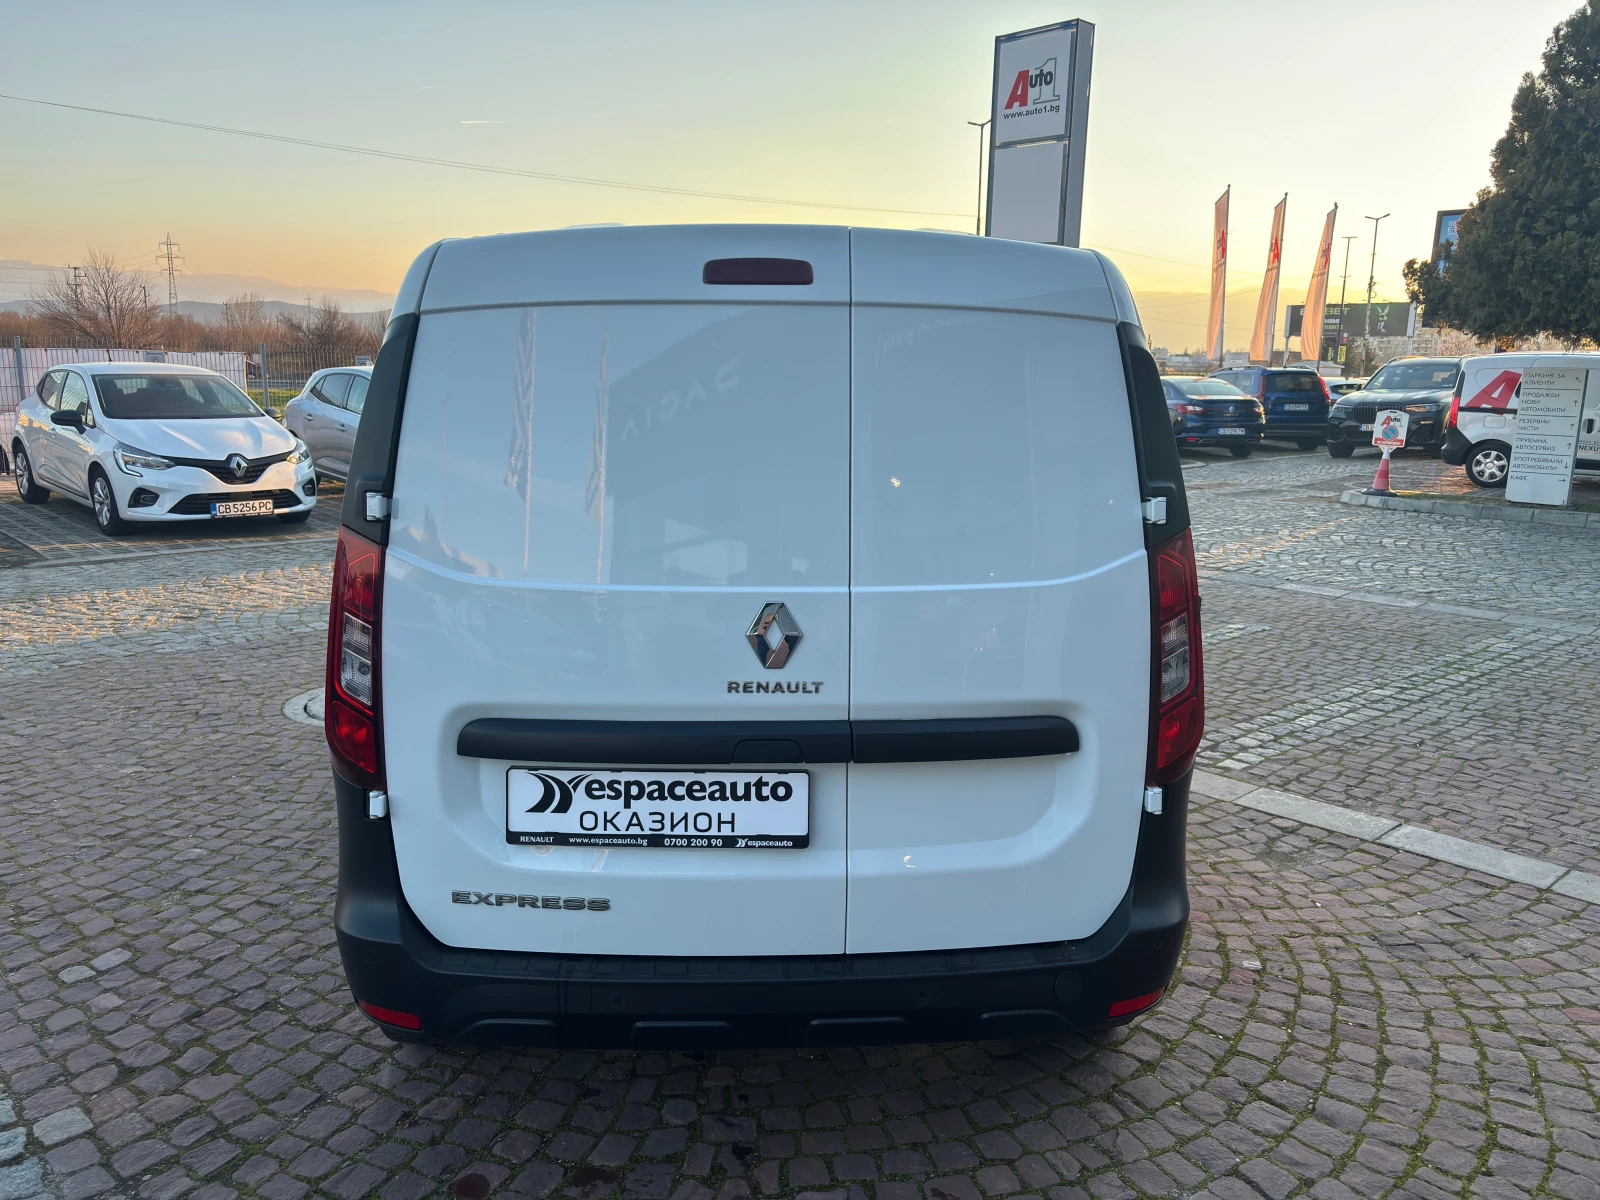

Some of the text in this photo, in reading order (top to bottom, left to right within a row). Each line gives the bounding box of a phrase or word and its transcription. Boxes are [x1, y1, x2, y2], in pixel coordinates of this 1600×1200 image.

[1003, 104, 1060, 119] www.auto1.bg
[1514, 444, 1556, 452] АВТОСЕРВИЗ
[1513, 456, 1563, 464] УПОТРЕБЯВАНИ
[1511, 463, 1558, 471] АВТОМОБИЛИ
[218, 501, 272, 514] CB 5256 PC
[727, 681, 824, 694] RENAULT
[584, 775, 794, 809] espaceauto
[579, 811, 736, 832] ОКАЗИОН
[568, 836, 648, 846] www.espaceauto.bg
[664, 838, 688, 846] 0700
[690, 838, 708, 846] 200
[710, 839, 723, 847] 90
[747, 839, 793, 848] espaceauto
[451, 890, 611, 911] EXPRESS
